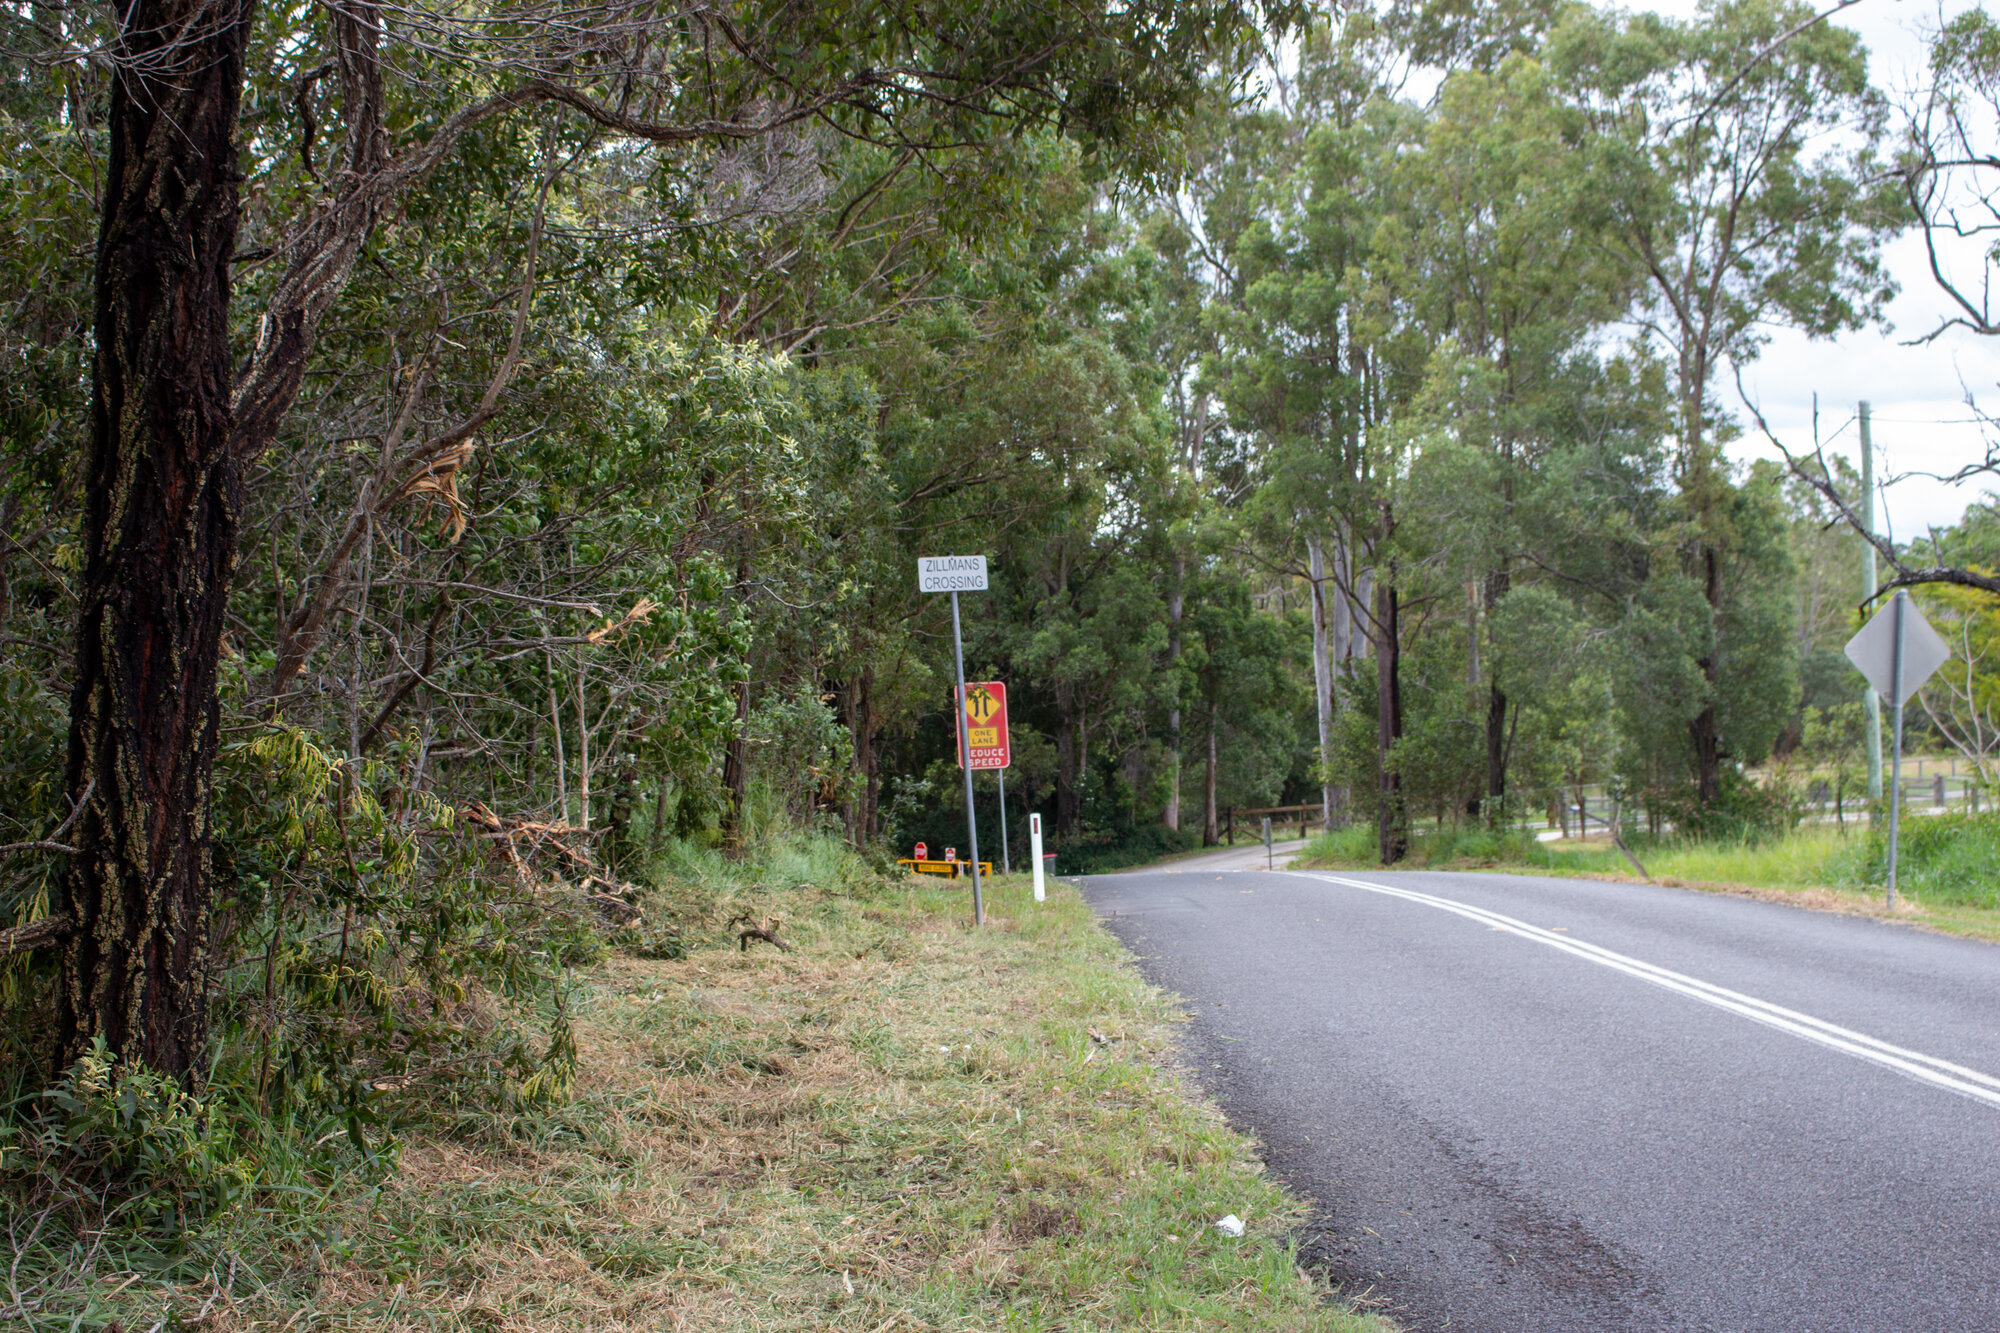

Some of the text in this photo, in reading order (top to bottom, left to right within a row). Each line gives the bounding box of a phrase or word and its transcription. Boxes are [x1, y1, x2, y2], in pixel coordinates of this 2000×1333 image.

[926, 558, 979, 572] ZILLMANS
[925, 575, 983, 589] CROSSING
[970, 748, 1005, 757] EDUCE
